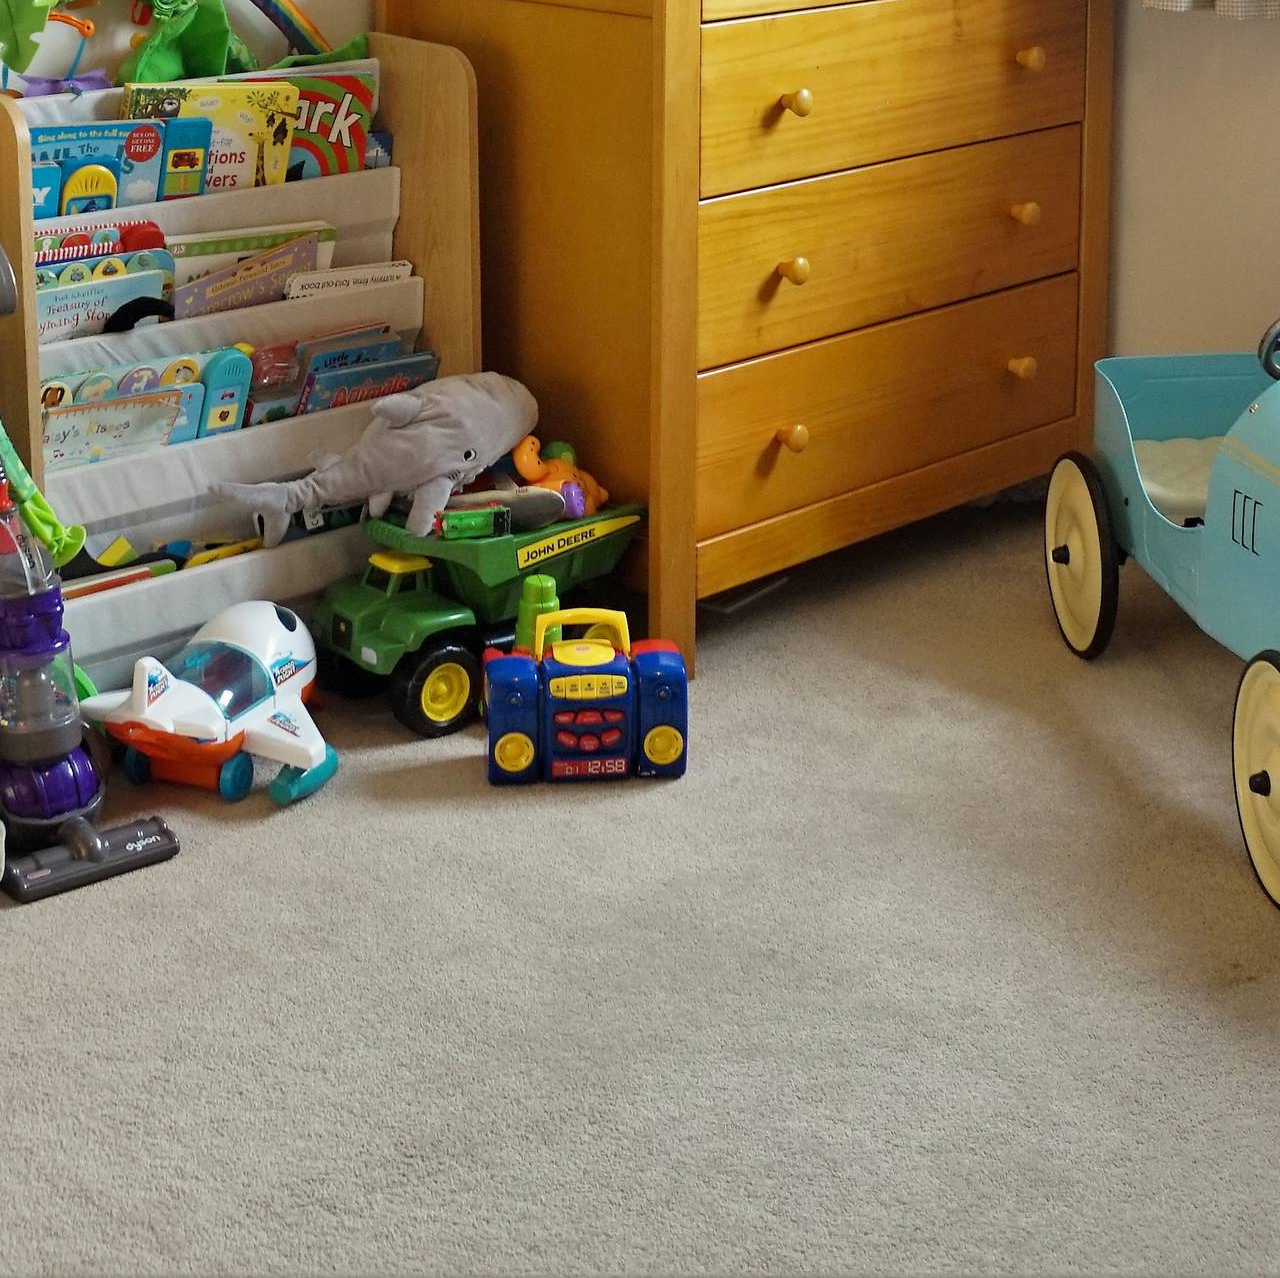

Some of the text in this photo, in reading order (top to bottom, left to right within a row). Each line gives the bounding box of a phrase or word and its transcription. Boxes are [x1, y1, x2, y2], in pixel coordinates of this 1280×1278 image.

[293, 91, 363, 148] ark
[57, 131, 77, 141] along
[79, 129, 88, 138] to
[89, 128, 102, 137] the
[104, 127, 118, 137] full
[78, 142, 100, 155] The
[130, 144, 155, 153] FREE
[47, 295, 108, 316] Treasury of
[523, 528, 596, 563] JOHN DEERE
[588, 758, 626, 774] 12:58
[125, 835, 161, 852] dyson
